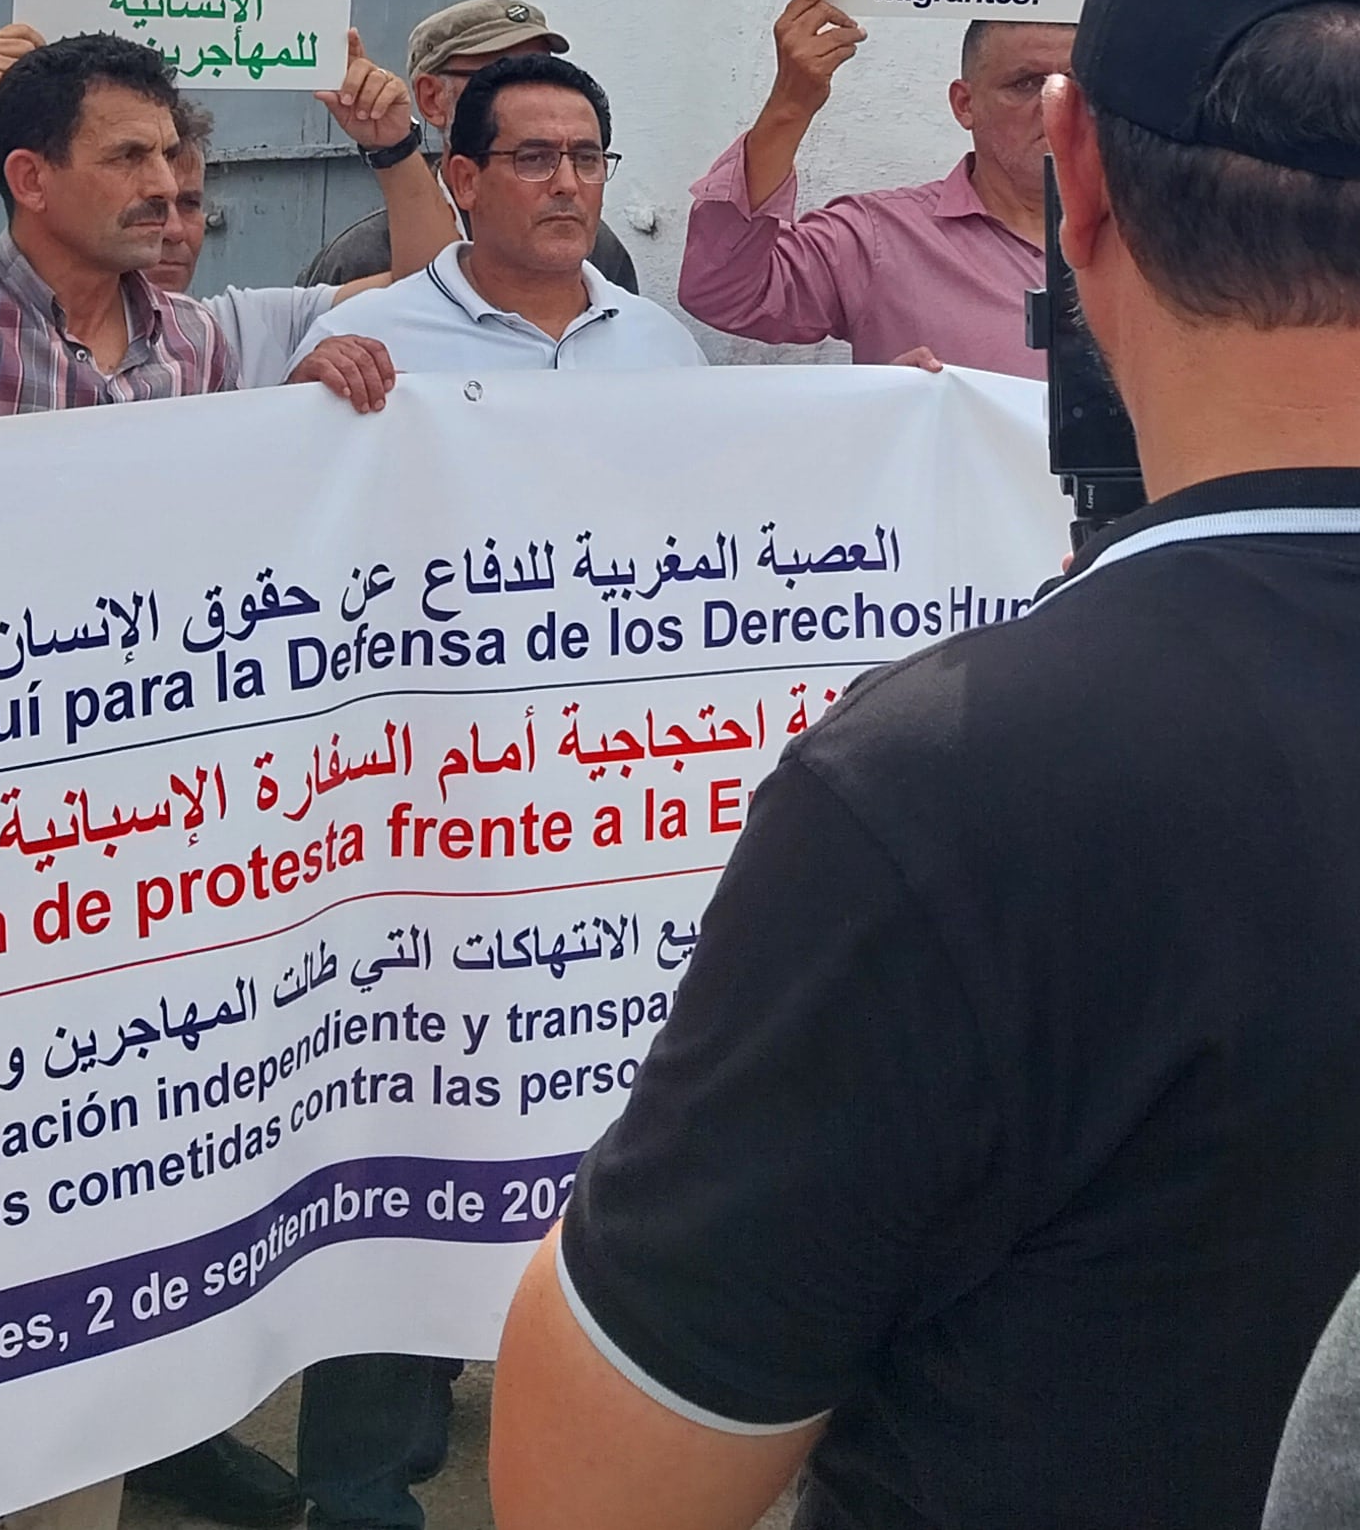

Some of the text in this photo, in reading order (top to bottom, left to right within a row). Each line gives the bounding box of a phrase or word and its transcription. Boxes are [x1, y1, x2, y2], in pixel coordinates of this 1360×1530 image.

[340, 563, 396, 622] عن
[421, 537, 555, 623] للدفاع
[572, 530, 738, 602] المغربية
[757, 521, 900, 590] العصبة
[182, 567, 321, 654] حقوق
[65, 670, 195, 745] para
[216, 649, 266, 703] la
[287, 622, 506, 691] Defensa
[526, 611, 590, 662] de
[610, 607, 683, 656] los
[255, 721, 413, 821] السفارة
[438, 705, 536, 800] أمام
[558, 702, 765, 781] احتجاجية
[32, 881, 112, 944] de
[137, 822, 364, 939] protesta
[387, 801, 573, 860] frente
[592, 805, 623, 848] a
[645, 787, 687, 842] la
[273, 939, 338, 1008] طالت
[350, 924, 432, 994] التي
[452, 914, 639, 980] الانتهاكات
[44, 976, 257, 1079] المهاجرين
[157, 1009, 446, 1122] independiente
[462, 1014, 490, 1056] y
[506, 995, 679, 1043] transpa
[48, 1109, 281, 1214] cometidas
[290, 1066, 414, 1133] contra
[432, 1064, 501, 1107] las
[86, 1286, 114, 1335] 2
[132, 1271, 189, 1320] de
[203, 1182, 410, 1296] septiembre
[427, 1180, 485, 1223] de
